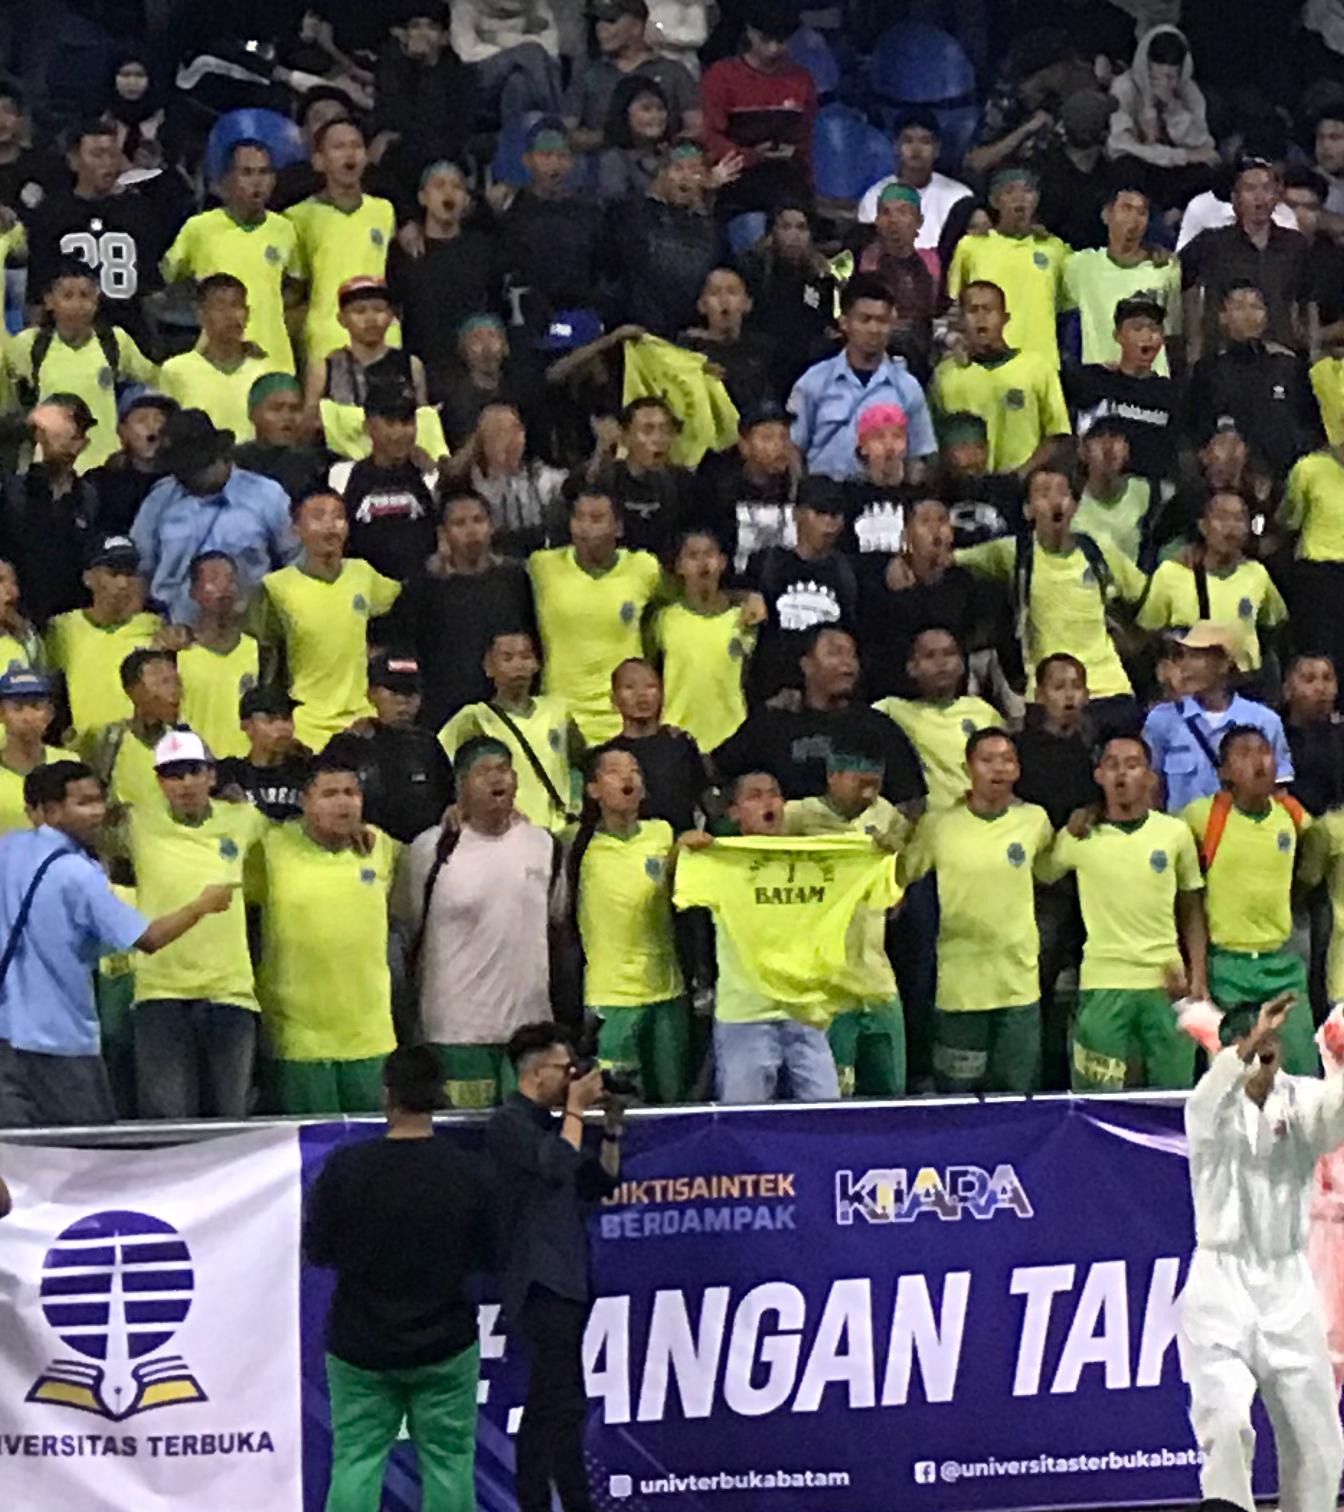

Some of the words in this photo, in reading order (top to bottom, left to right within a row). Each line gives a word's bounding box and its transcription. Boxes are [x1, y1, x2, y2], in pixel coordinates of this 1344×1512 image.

[754, 886, 825, 904] BATAM
[600, 1204, 797, 1239] BERDAMPAK
[477, 1270, 972, 1434] ANGAN
[1009, 1257, 1190, 1397] TAK
[147, 1431, 274, 1457] TERBUKA
[939, 1447, 1204, 1483] @universitasterbukabata
[640, 1470, 850, 1494] univterbukabatam
